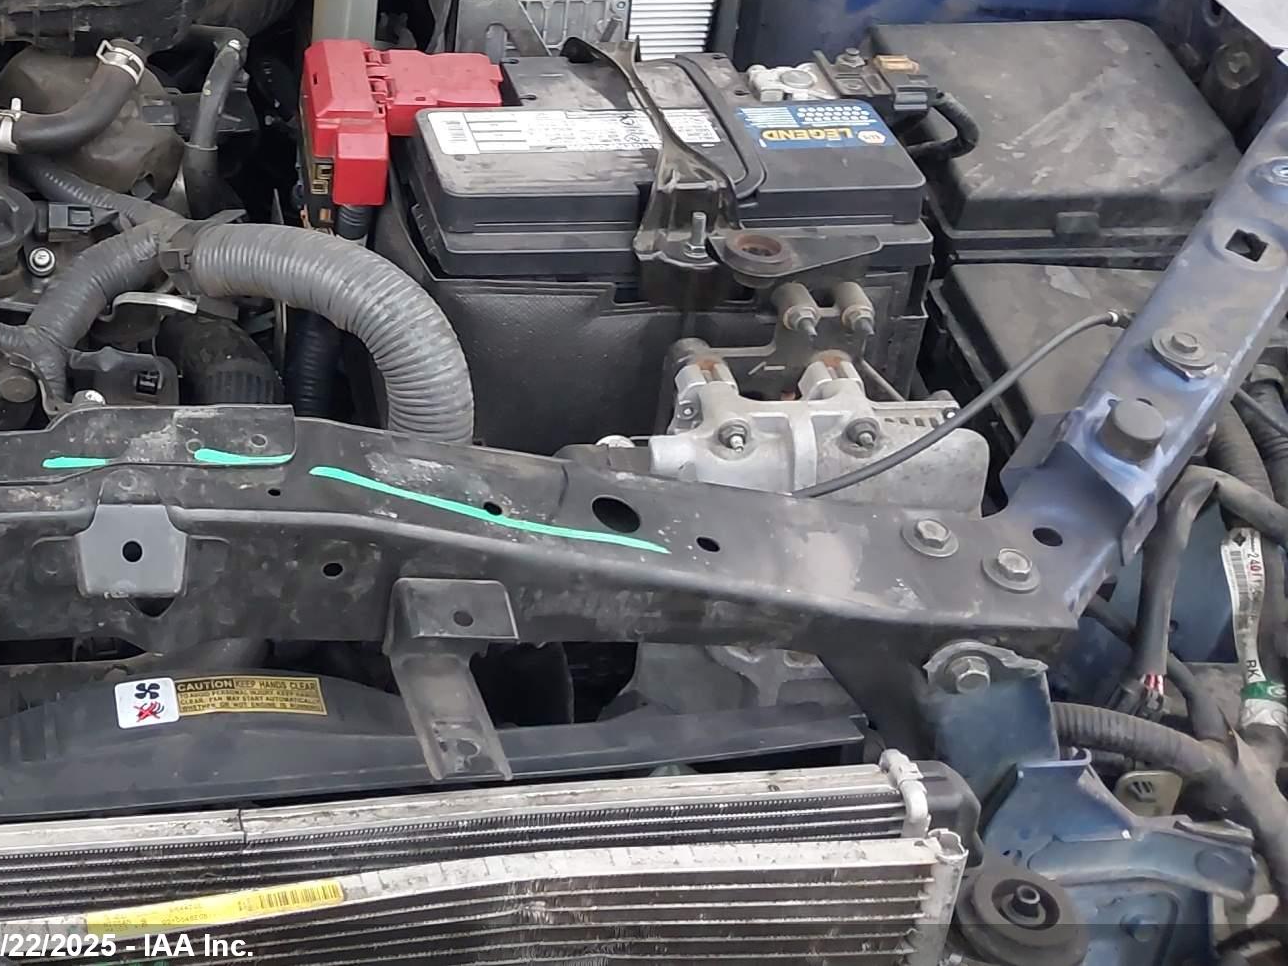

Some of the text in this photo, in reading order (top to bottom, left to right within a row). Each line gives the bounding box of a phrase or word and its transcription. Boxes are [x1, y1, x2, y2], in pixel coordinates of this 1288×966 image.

[762, 127, 854, 141] LEGEND
[1246, 659, 1262, 679] RK
[176, 679, 316, 692] CAUTION KEEP HANDS CLEAR
